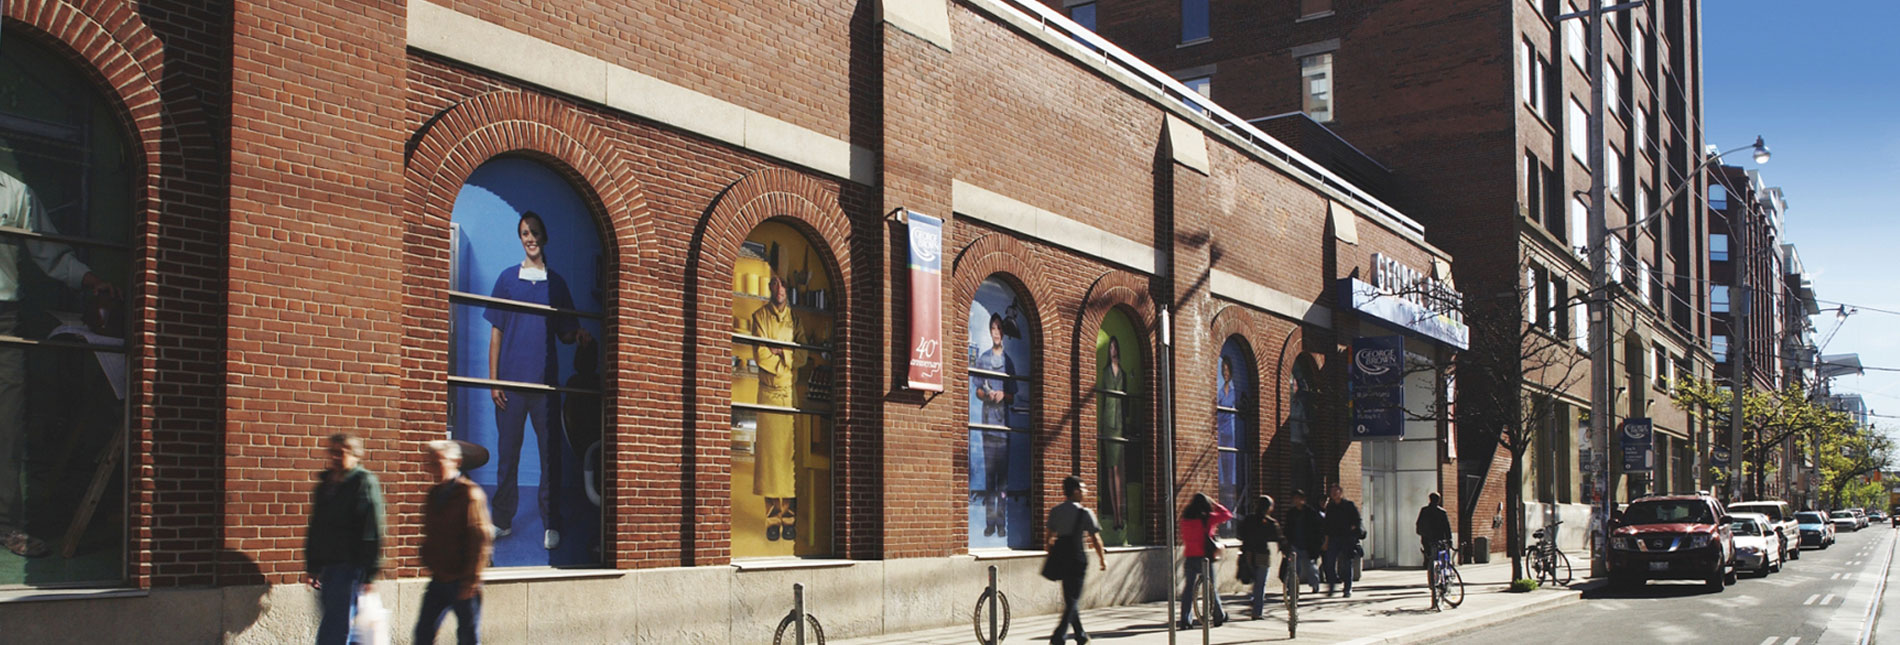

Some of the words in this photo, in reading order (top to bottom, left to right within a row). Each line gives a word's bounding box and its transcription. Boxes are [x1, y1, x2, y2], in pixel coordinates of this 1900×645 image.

[1372, 252, 1426, 309] GEORGE
[1361, 349, 1394, 358] GEORGE
[1366, 355, 1397, 365] BROWN
